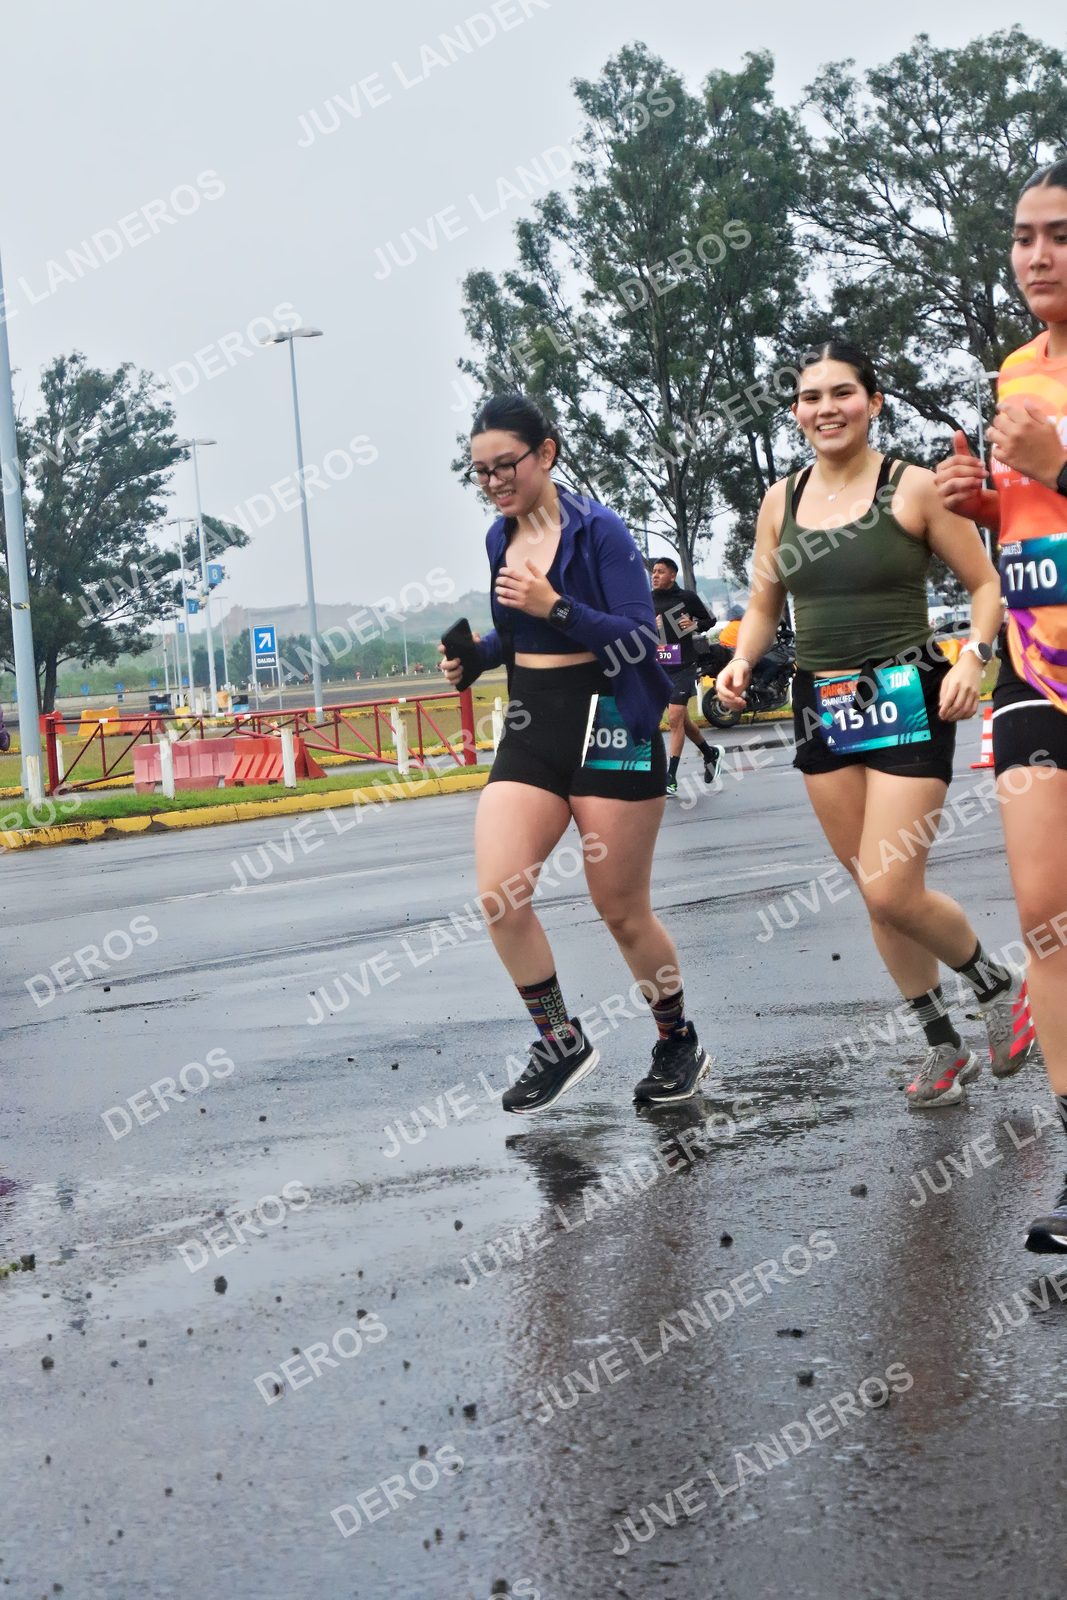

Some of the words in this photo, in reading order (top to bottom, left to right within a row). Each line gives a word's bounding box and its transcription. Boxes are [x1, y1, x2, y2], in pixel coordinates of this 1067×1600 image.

[1006, 558, 1058, 592] 1710
[889, 671, 911, 688] 10K
[834, 701, 898, 731] 1510
[540, 993, 566, 1040] CORRER
